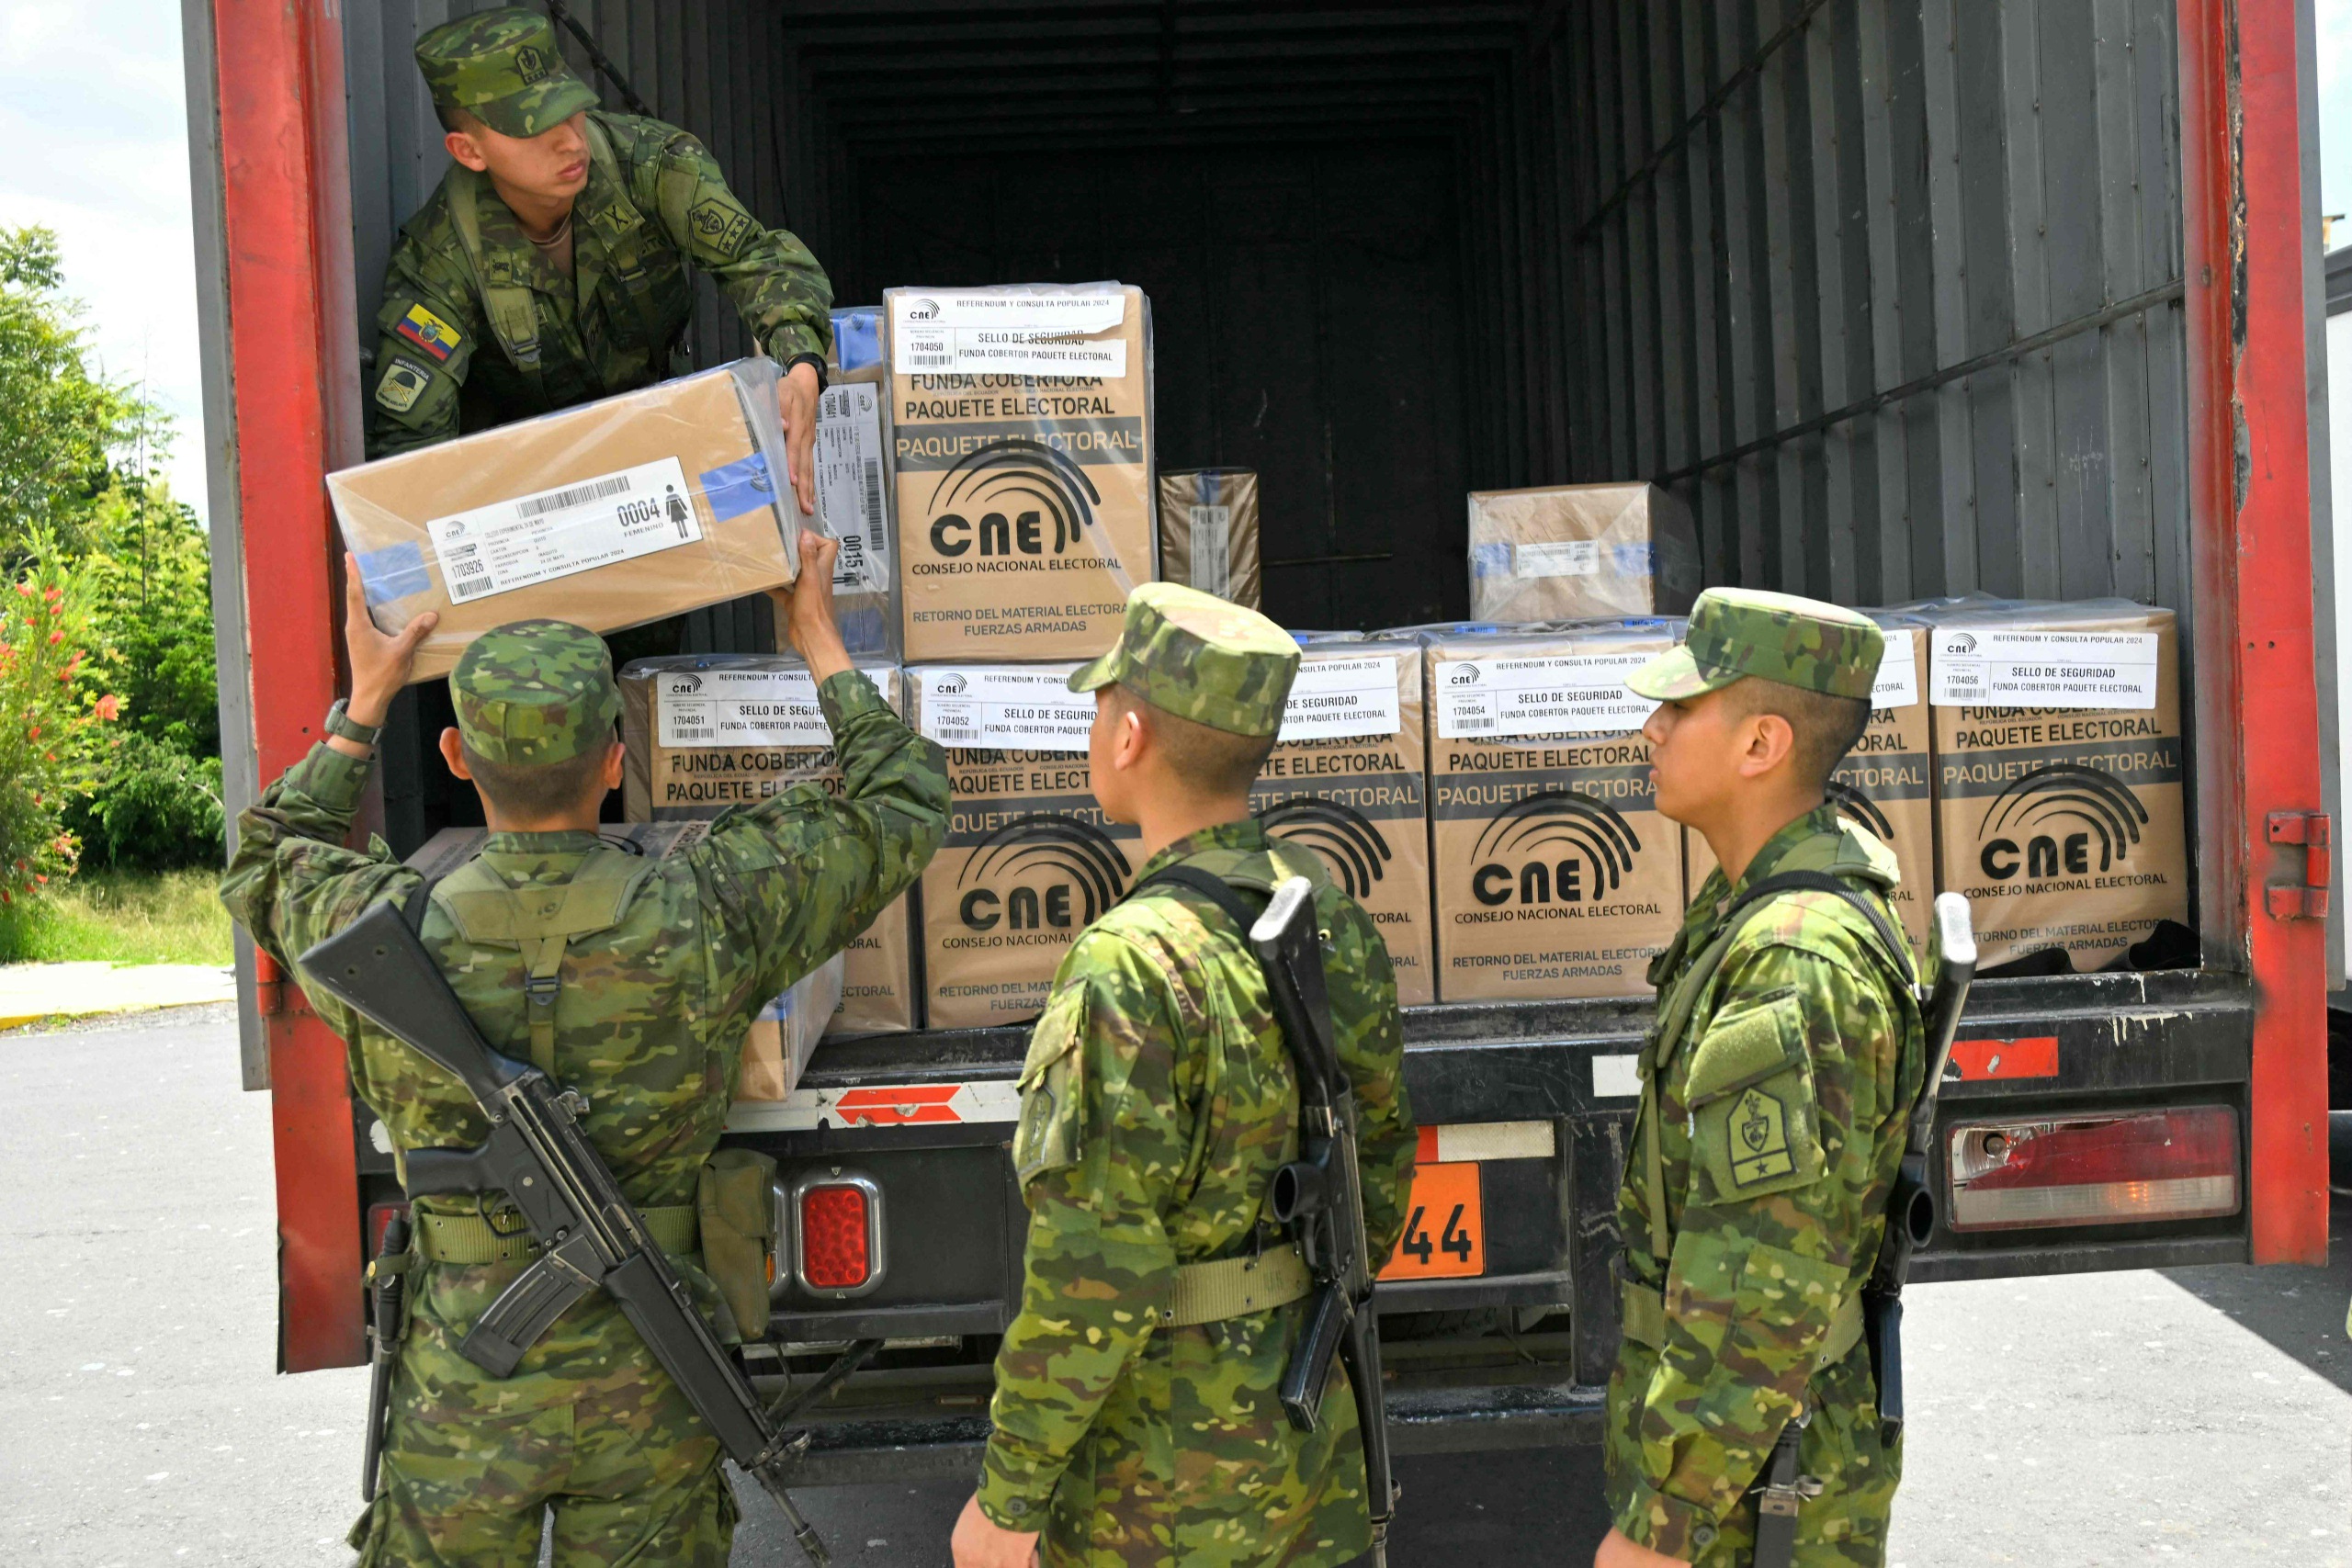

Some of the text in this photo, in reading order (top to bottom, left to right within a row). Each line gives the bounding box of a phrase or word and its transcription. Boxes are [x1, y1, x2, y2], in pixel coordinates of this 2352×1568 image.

[978, 333, 1008, 343] SELLO
[1012, 333, 1024, 343] DE
[911, 343, 944, 351] 1704050
[959, 349, 1113, 361] FUNDA COBERTOR PAQUETE ELECTORAL
[395, 358, 429, 379] INFANTERIA
[911, 374, 976, 390] FUNDA
[906, 397, 1114, 419] PAQUETE ELECTORAL
[897, 434, 1001, 457] PAQUETE
[617, 497, 660, 527] 0004
[624, 522, 663, 537] FEMENINO
[931, 511, 1042, 557] CNE
[843, 536, 863, 568] 0015
[452, 558, 484, 579] 1703926
[501, 570, 541, 586] REFERENDUM
[548, 558, 580, 572] CONSULTA
[581, 552, 609, 564] POPULAR
[610, 548, 625, 557] 2024
[912, 558, 1121, 575] CONSEJO NACIONAL ELECTORAL
[913, 610, 972, 622] RETORNO
[976, 609, 999, 619] DEL
[1002, 606, 1062, 617] MATERIAL
[965, 621, 1086, 636] FUERZAS ARMADAS
[1497, 661, 1544, 670] REFERENDUM
[1555, 659, 1591, 667] CONSULTA
[985, 675, 1034, 683] REFERENDUM
[1947, 676, 1978, 684] 1704056
[2012, 668, 2115, 678] SELLO DE SEGURIDAD
[2100, 684, 2142, 693] ELECTORAL
[1286, 696, 1357, 709] DE SEGURIDAD
[1519, 690, 1622, 704] SELLO DE SEGURIDAD
[740, 705, 769, 716] SELLO
[774, 706, 785, 715] DE
[1004, 709, 1034, 718] SELLO
[1038, 710, 1050, 719] DE
[1307, 710, 1386, 723] PAQUETE ELECTORAL
[1453, 706, 1485, 715] 1704054
[1500, 705, 1650, 719] FUNDA COBERTOR PAQUETE ELECTORAL
[673, 716, 705, 725] 1704051
[794, 722, 827, 730] PAQUETE
[937, 716, 968, 726] 1704052
[1014, 726, 1055, 734] COBERTOR
[1956, 717, 2161, 749] PAQUETE ELECTORAL
[673, 754, 735, 773] FUNDA
[1293, 753, 1405, 774] ELECTORAL
[1450, 751, 1537, 771] PAQUETE
[1836, 766, 1923, 787] CTORAL
[667, 781, 753, 801] PAQUETE
[1438, 784, 1538, 806] PAQUETE
[1981, 833, 2088, 880] CNE
[1473, 859, 1580, 906] CNE
[1963, 874, 2167, 899] CONSEJO NACIONAL ELECTORAL
[960, 885, 1070, 931] CNE
[1455, 904, 1660, 924] CONSEJO NACIONAL ELECTORAL
[1972, 923, 2105, 942] TORNO DEL MATERIAL
[943, 933, 1073, 949] CONSEJO NACIONAL
[2069, 937, 2127, 951] ARMADAS
[1453, 951, 1599, 967] RETORNO DEL MATERIAL
[1503, 965, 1622, 980] FUERZAS ARMADAS
[940, 985, 998, 997] RETORNO
[1002, 984, 1025, 994] DEL
[990, 998, 1046, 1010] FUERZAS
[1403, 1204, 1471, 1264] 44
